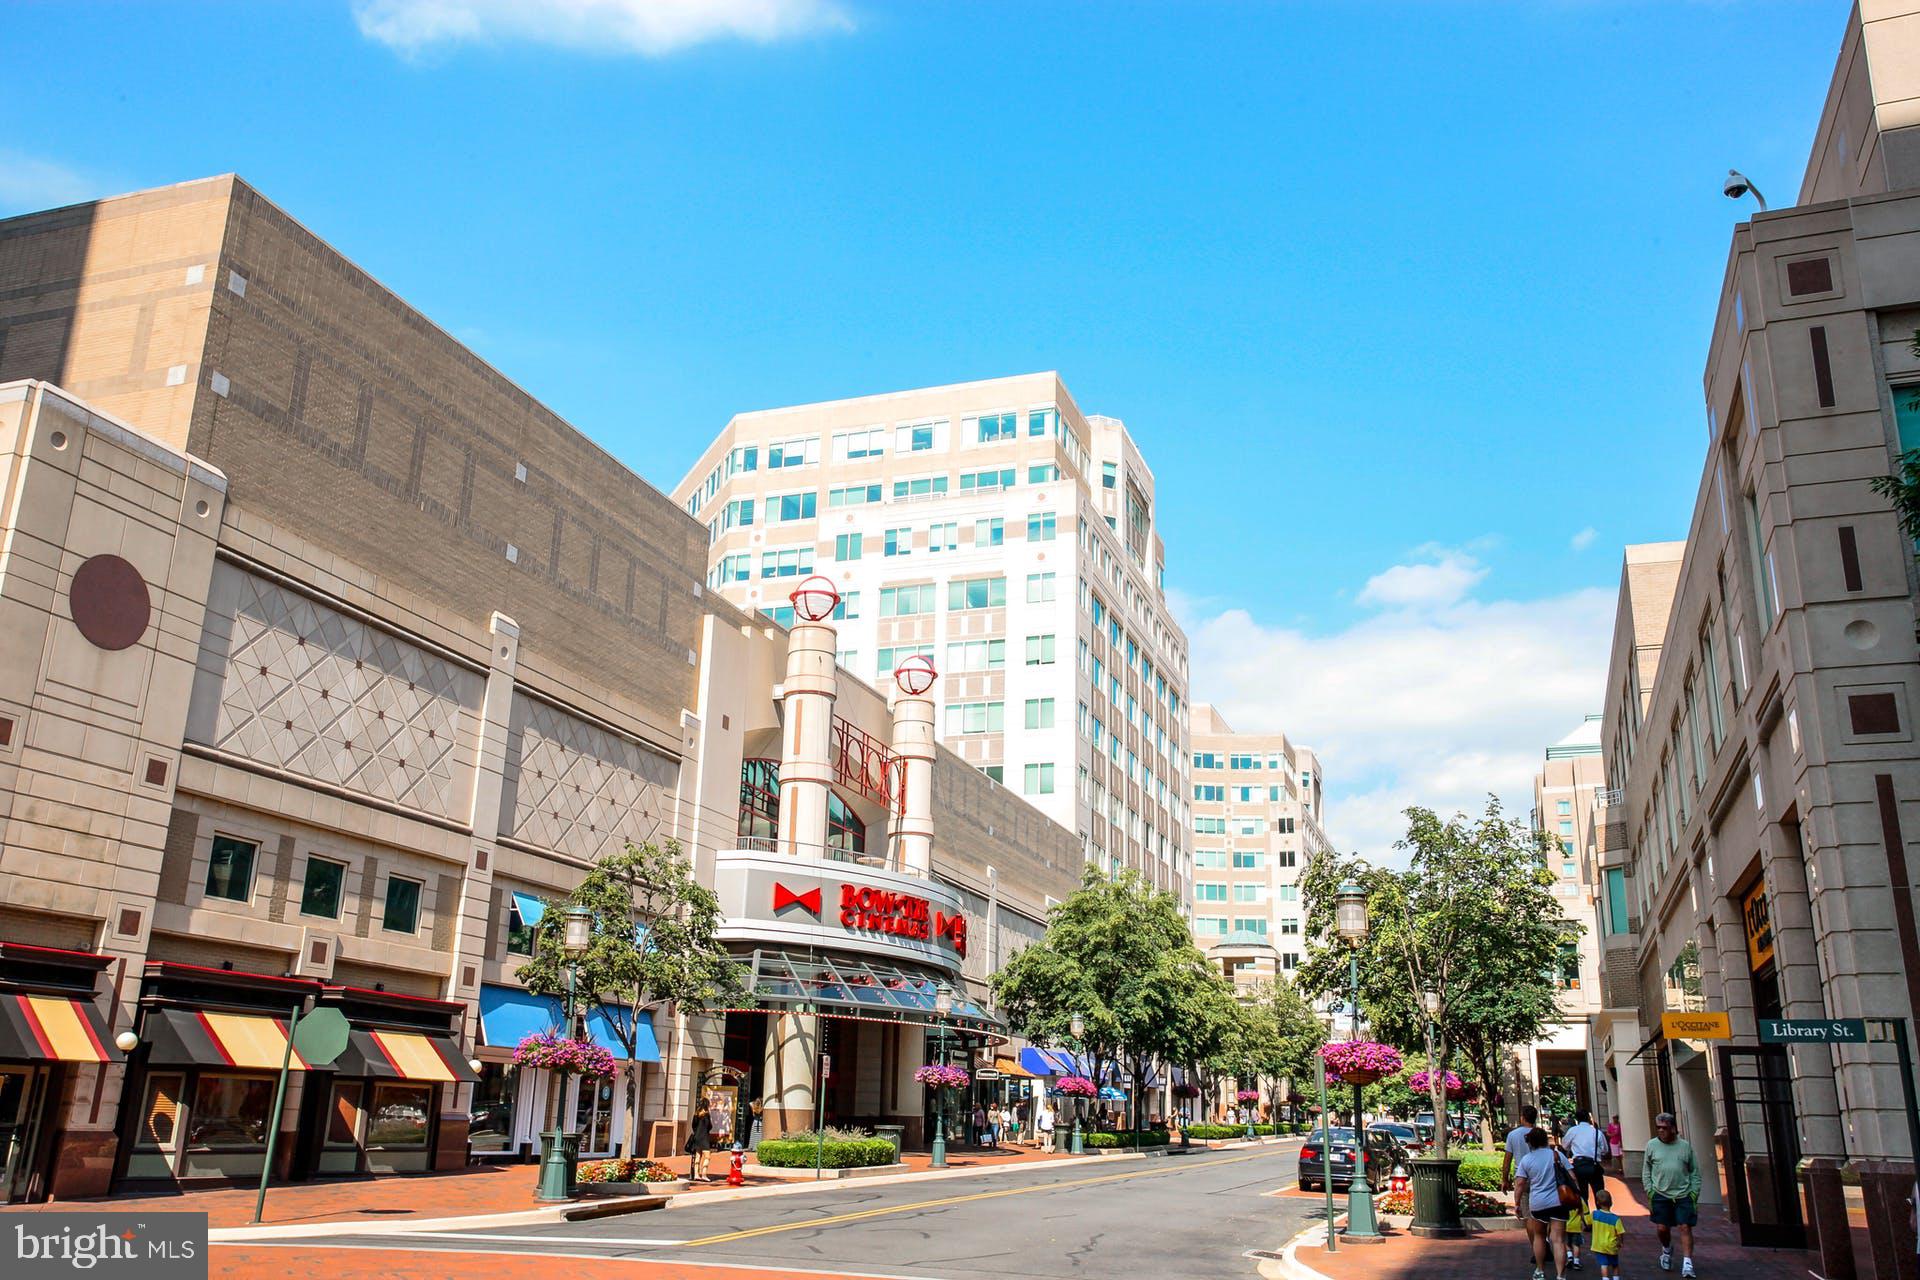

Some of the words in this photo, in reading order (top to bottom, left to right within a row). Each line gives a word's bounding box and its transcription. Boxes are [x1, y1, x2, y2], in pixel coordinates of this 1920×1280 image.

[840, 909, 929, 939] CINEMAS
[1772, 1023, 1828, 1039] Library
[1832, 1023, 1854, 1037] St.
